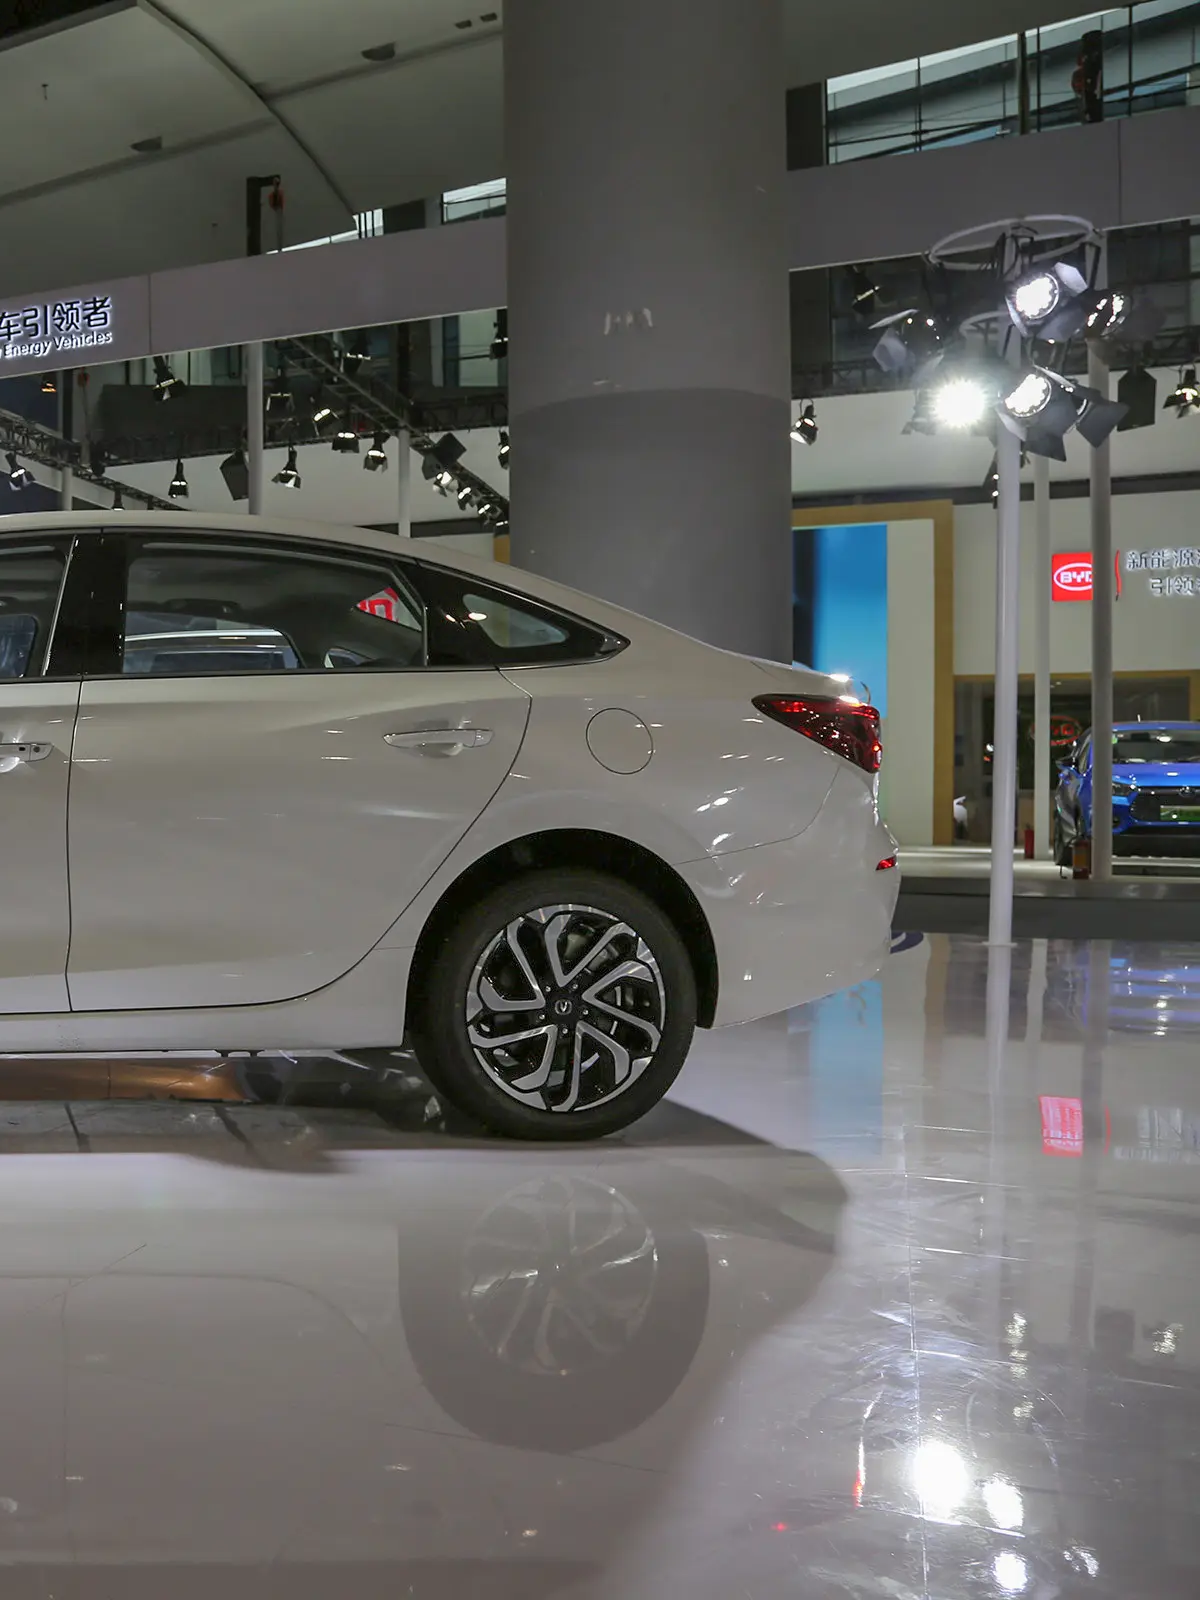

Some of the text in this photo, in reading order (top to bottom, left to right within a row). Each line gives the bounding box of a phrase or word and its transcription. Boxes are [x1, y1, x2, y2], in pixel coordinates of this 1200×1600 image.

[3, 340, 52, 359] Energy
[52, 330, 113, 351] Vehicles
[1126, 548, 1200, 570] 新能源
[1149, 575, 1200, 597] 引领
